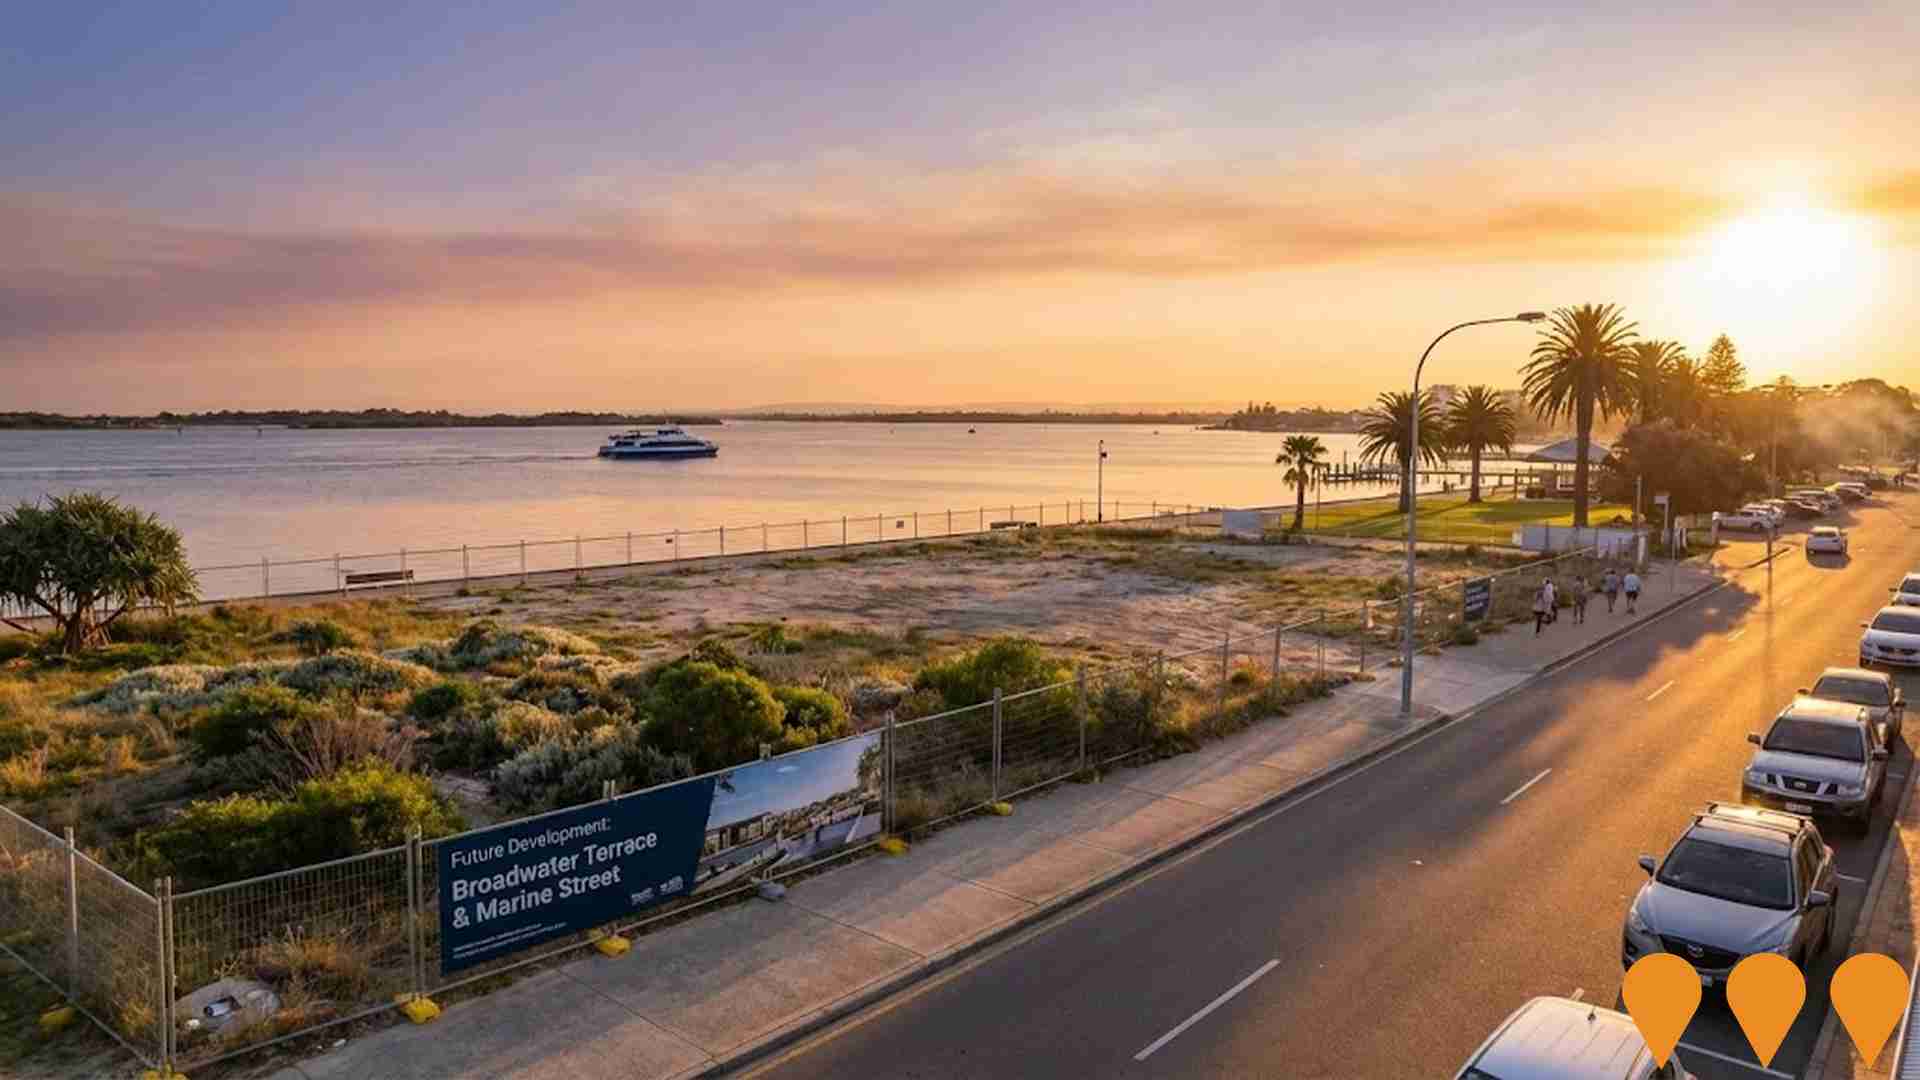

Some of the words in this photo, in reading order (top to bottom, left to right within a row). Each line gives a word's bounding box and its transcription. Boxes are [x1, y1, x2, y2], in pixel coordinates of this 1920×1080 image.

[451, 844, 504, 869] Future
[508, 817, 611, 854] Development:
[452, 854, 579, 902] Broadwater
[583, 832, 657, 865] Terrace
[452, 906, 471, 929] &
[476, 887, 553, 923] Marine
[559, 865, 621, 898] Street
